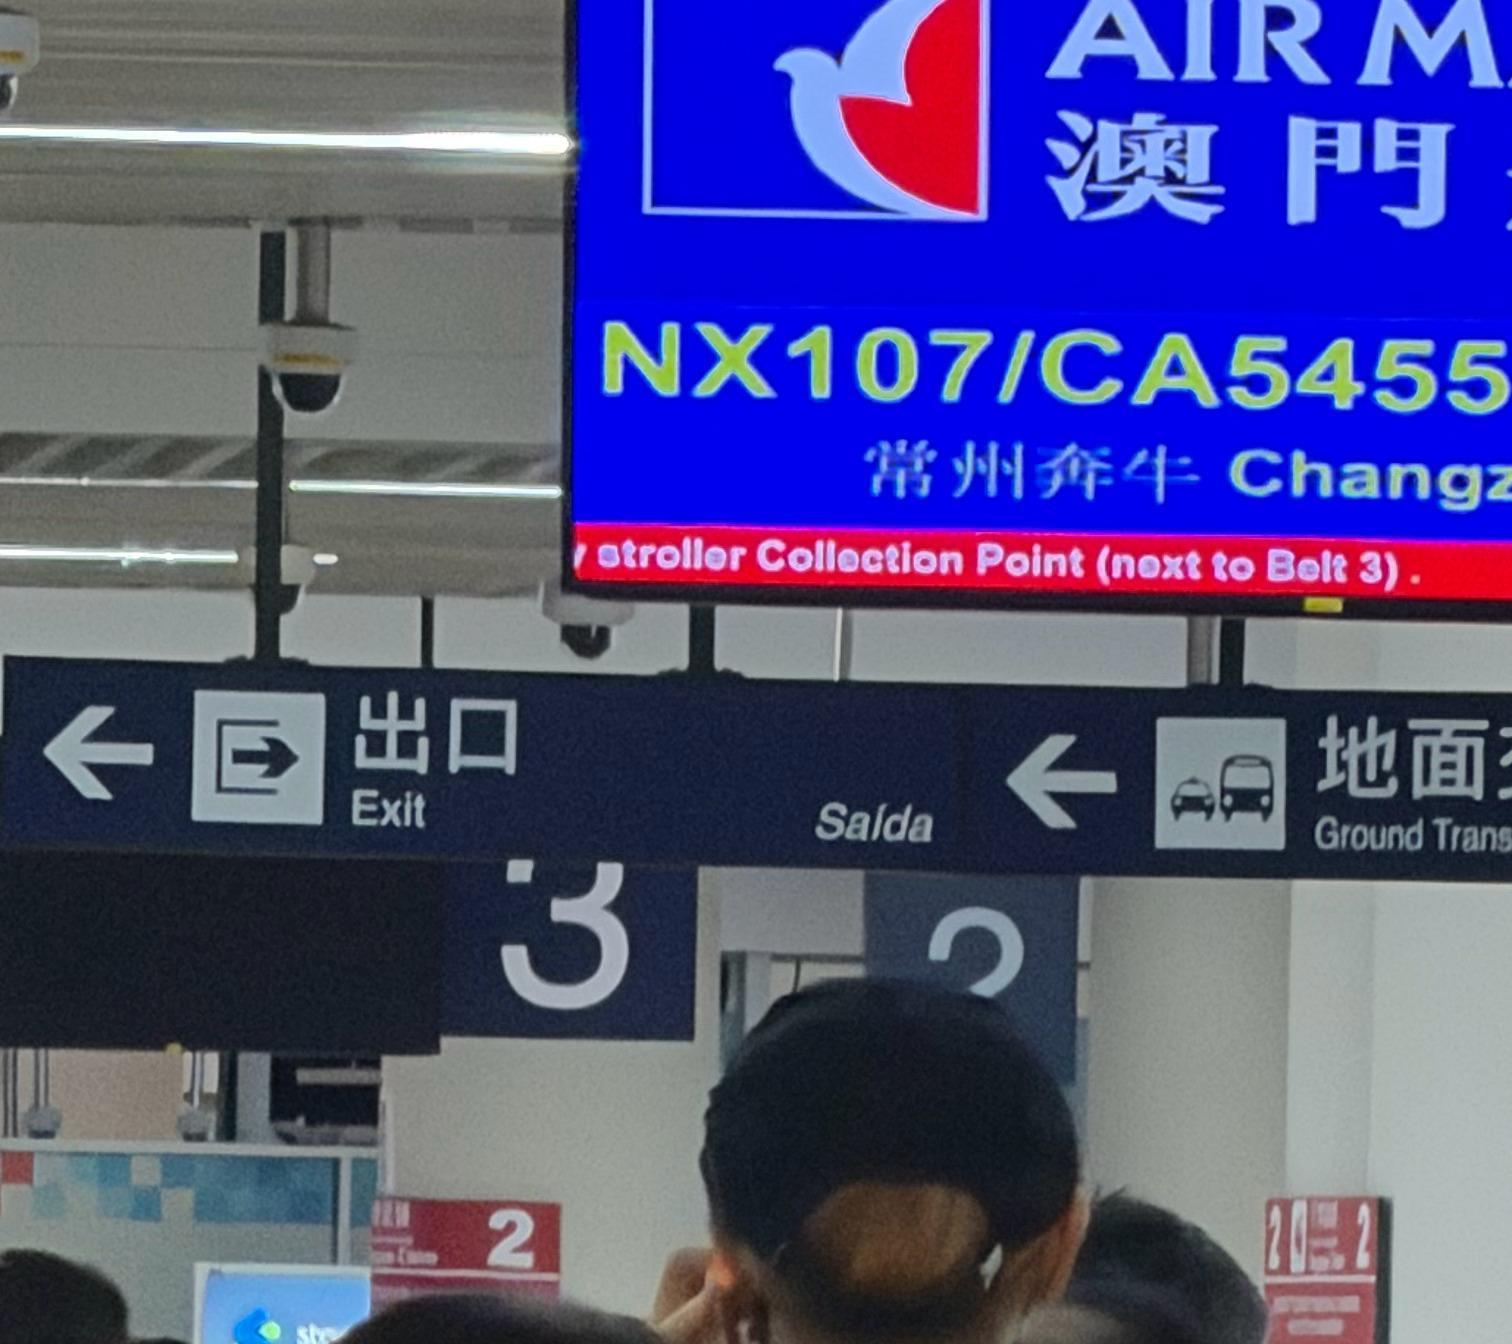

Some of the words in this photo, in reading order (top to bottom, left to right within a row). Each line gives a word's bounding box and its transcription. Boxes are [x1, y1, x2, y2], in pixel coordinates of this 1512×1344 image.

[1044, 0, 1331, 84] AIR
[602, 321, 1512, 415] NX107/CA5455
[863, 439, 1200, 504] 常州奔牛
[597, 537, 747, 572] stroller
[756, 538, 965, 576] Collection
[976, 542, 1086, 578] Point
[1096, 545, 1200, 586] (next
[1212, 549, 1255, 581] to
[1267, 549, 1347, 582] Belt
[353, 690, 518, 776] 出口
[351, 788, 427, 829] Exit
[814, 801, 934, 843] Saída
[1314, 815, 1424, 852] Ground
[500, 858, 629, 1010] 3
[487, 1208, 536, 1269] 2
